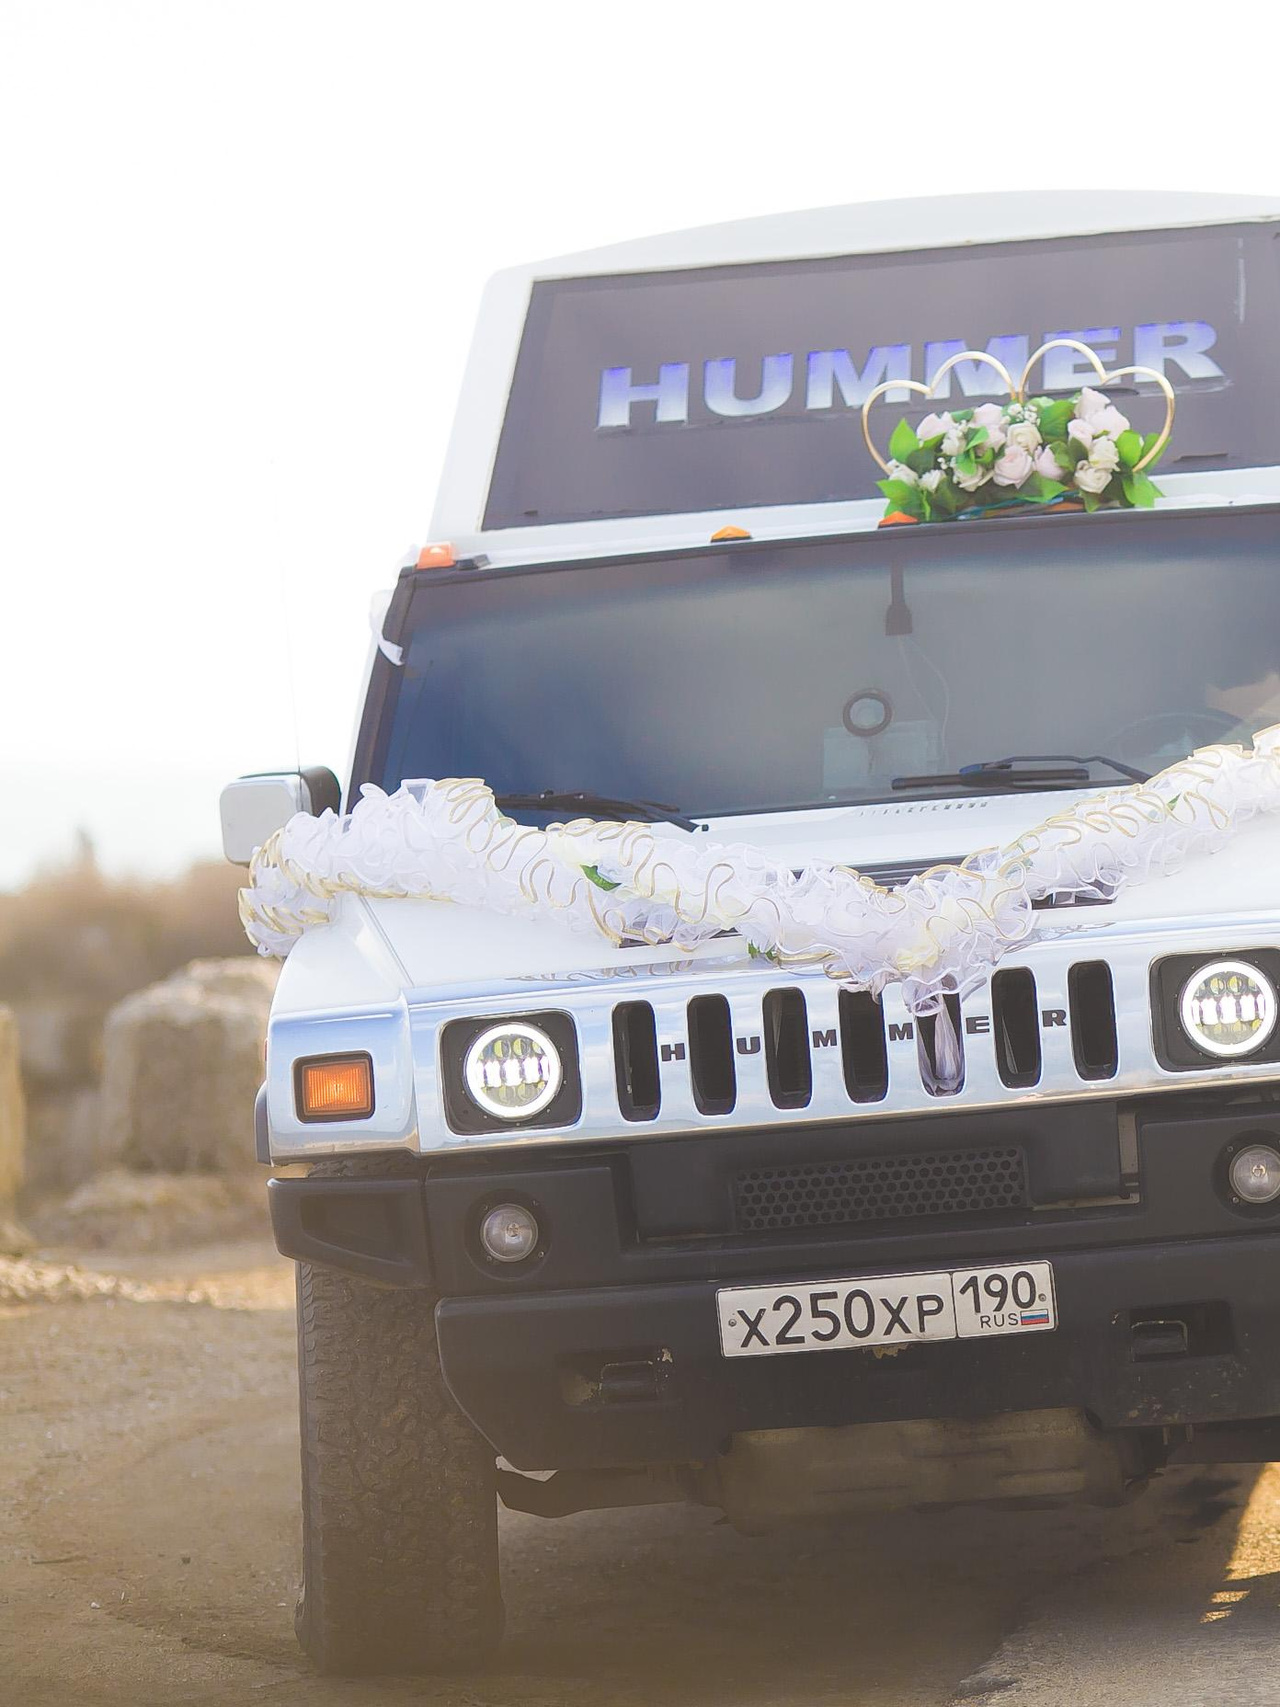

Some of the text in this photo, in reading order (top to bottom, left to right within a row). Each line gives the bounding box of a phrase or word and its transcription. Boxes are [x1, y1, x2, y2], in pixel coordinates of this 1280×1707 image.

[597, 321, 1226, 427] HUMMER
[660, 1008, 1067, 1062] HUMMER
[959, 1270, 1037, 1314] 190
[980, 1313, 1020, 1329] RUS
